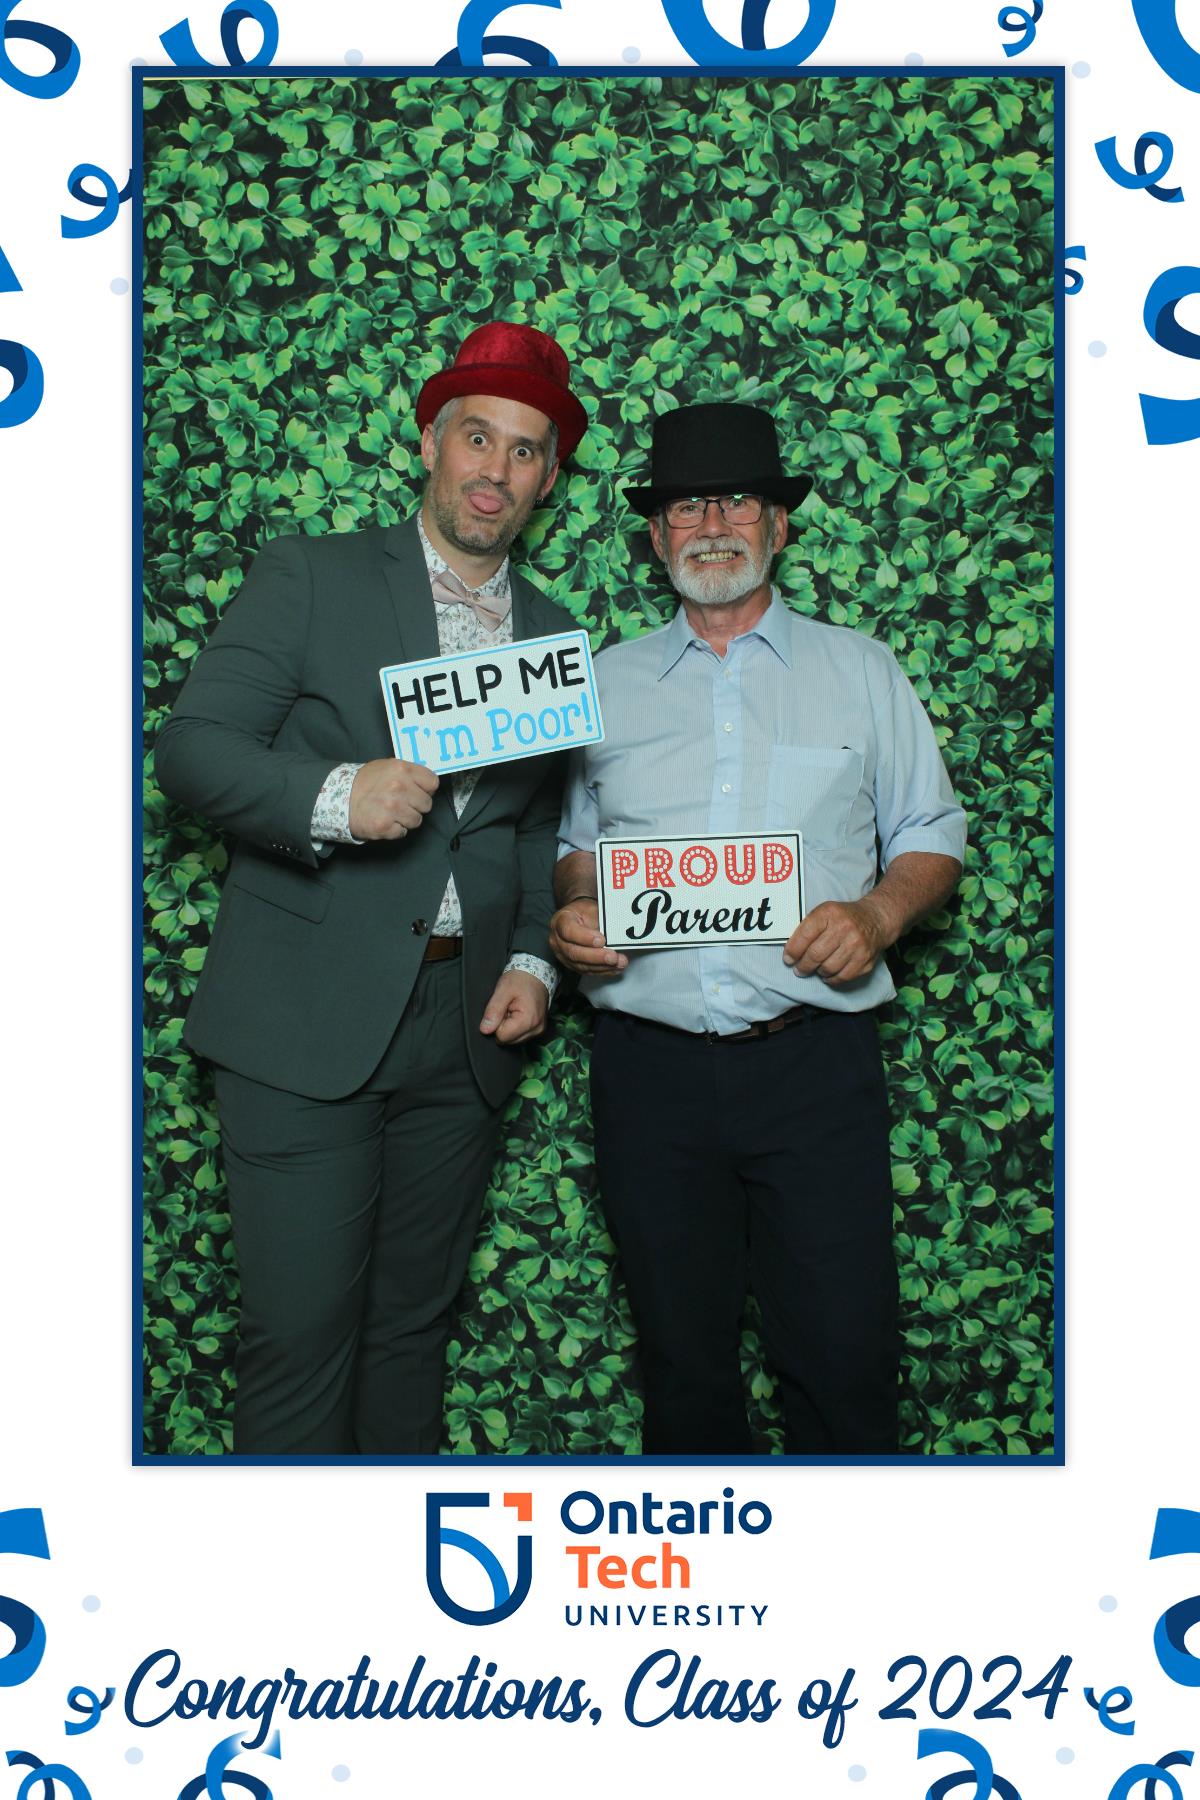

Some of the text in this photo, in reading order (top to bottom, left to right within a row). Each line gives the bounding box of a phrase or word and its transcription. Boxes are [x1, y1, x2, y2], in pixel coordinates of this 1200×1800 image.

[392, 647, 585, 719] HELP ME
[401, 692, 593, 765] I'm Poor!
[611, 843, 794, 889] PROUD
[626, 889, 773, 940] Parent
